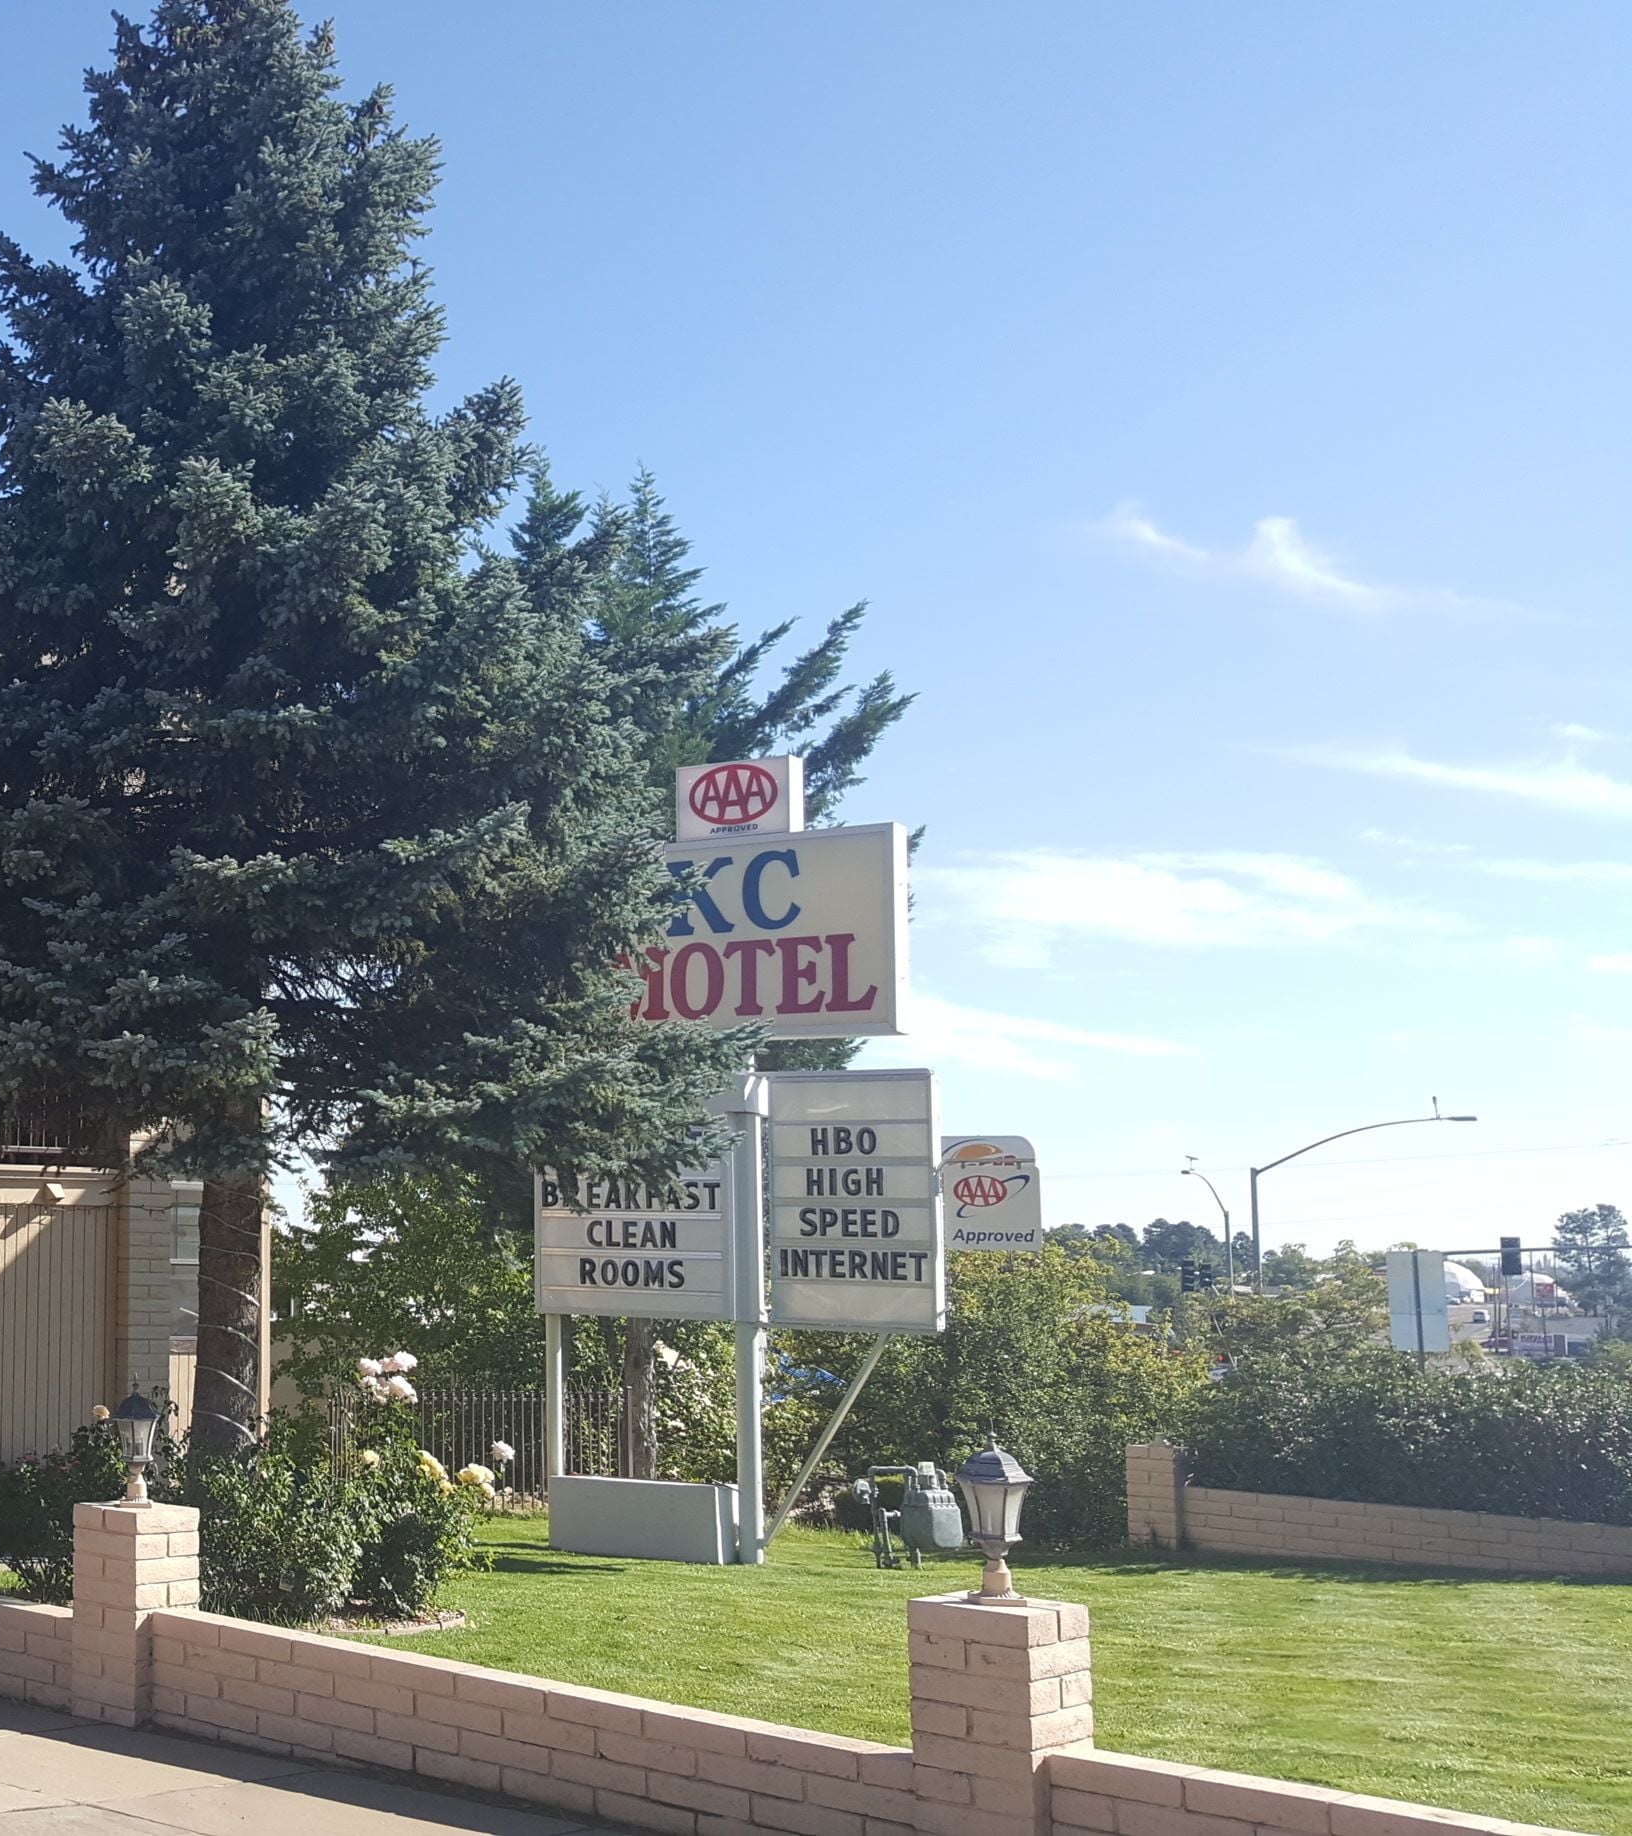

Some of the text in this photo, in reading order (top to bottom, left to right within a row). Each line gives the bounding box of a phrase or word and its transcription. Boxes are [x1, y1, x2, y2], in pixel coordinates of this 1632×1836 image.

[693, 765, 774, 824] AAA
[710, 823, 759, 835] APPROVED
[810, 1126, 877, 1156] HBO
[541, 1180, 721, 1211] BEAKFAST
[806, 1167, 884, 1197] HIGH
[955, 1175, 1006, 1207] AAA
[586, 1220, 677, 1249] CLEAN
[798, 1207, 900, 1239] SPEED
[952, 1228, 1036, 1245] Approved
[579, 1257, 686, 1289] ROOMS
[780, 1248, 929, 1282] INTERNET
